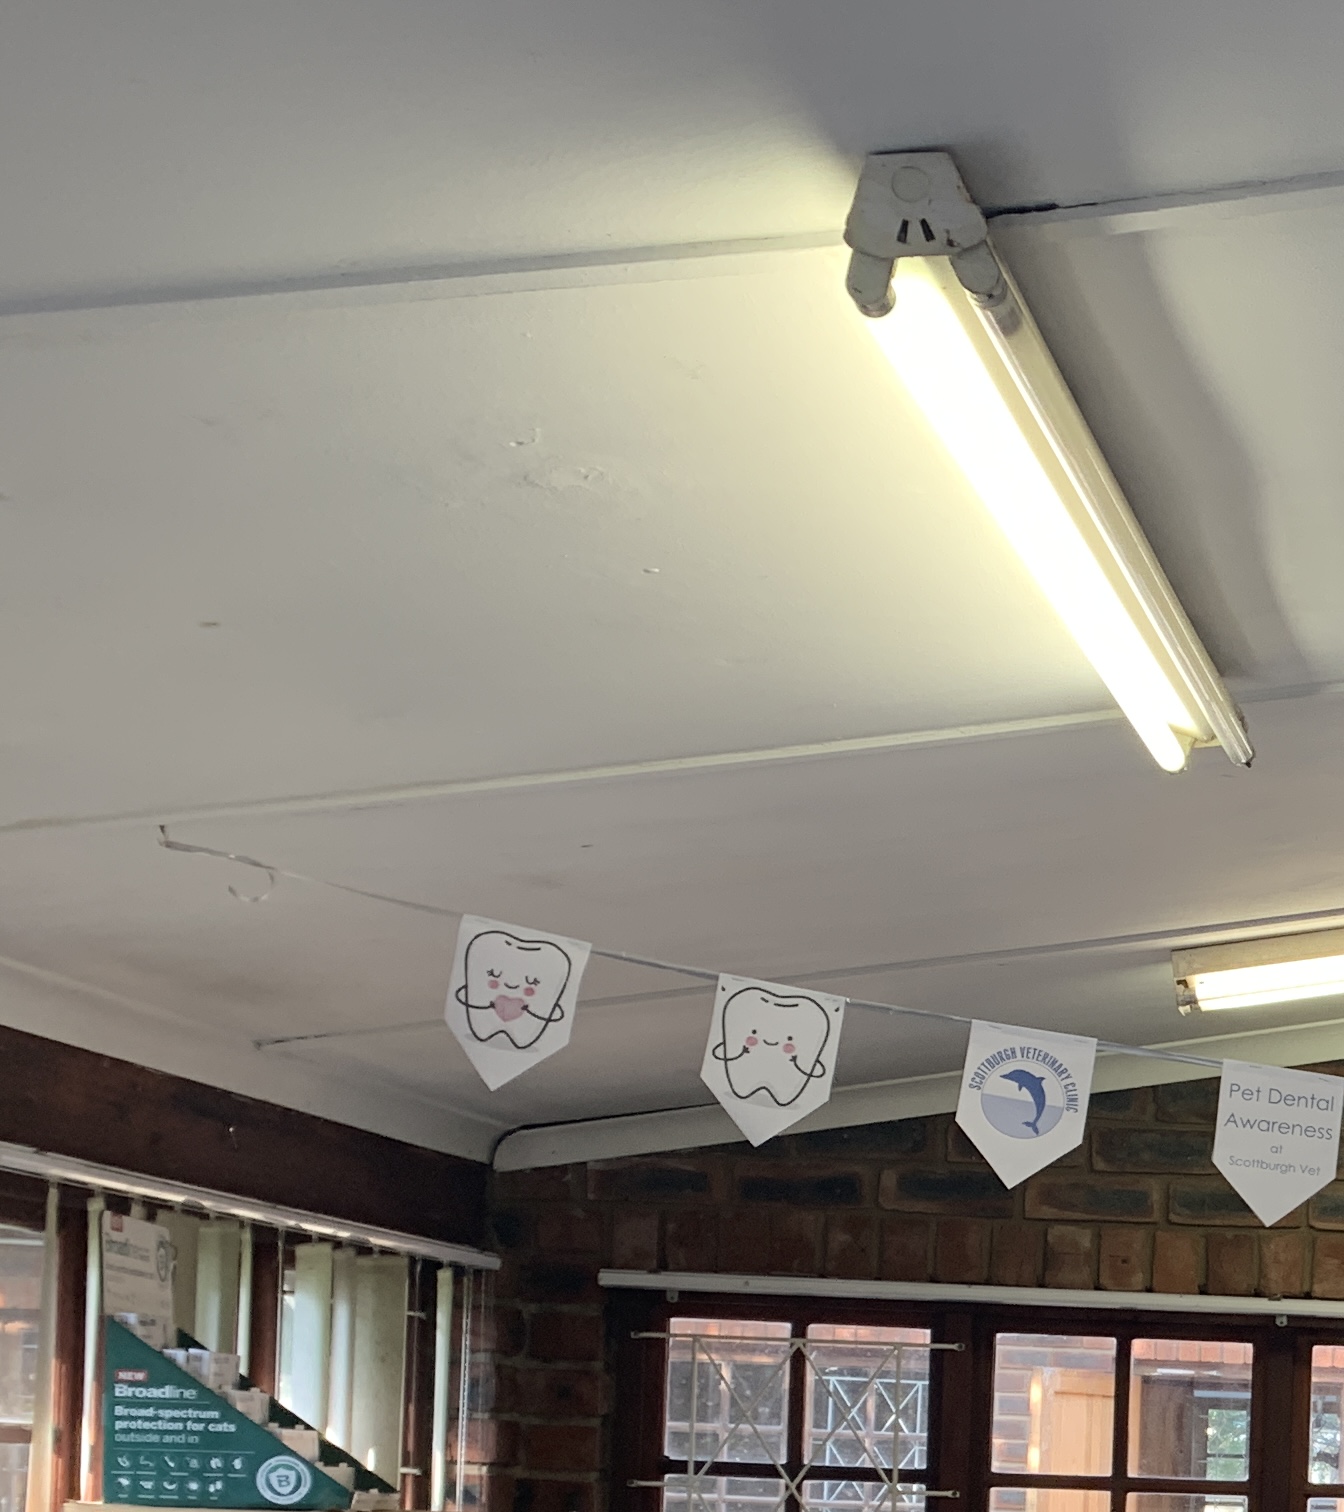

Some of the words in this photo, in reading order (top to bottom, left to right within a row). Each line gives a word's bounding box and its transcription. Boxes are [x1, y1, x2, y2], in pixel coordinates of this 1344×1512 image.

[968, 1046, 1018, 1091] SCOTTBURGH
[1019, 1045, 1073, 1086] VETERINARY
[1063, 1083, 1079, 1114] CLINIC
[1229, 1083, 1262, 1102] Pet
[1268, 1087, 1336, 1112] Dental
[1224, 1112, 1333, 1141] Awareness
[1270, 1143, 1283, 1155] at
[1228, 1155, 1297, 1175] Scottburgh
[1299, 1161, 1322, 1177] Vet
[116, 1371, 146, 1380] NEW
[114, 1384, 197, 1400] Broadline
[114, 1406, 221, 1421] Broad-spectrum
[114, 1419, 184, 1433] protection
[186, 1421, 205, 1432] for
[208, 1422, 236, 1433] cats
[114, 1432, 159, 1443] outside
[162, 1433, 184, 1443] and
[187, 1434, 199, 1443] in
